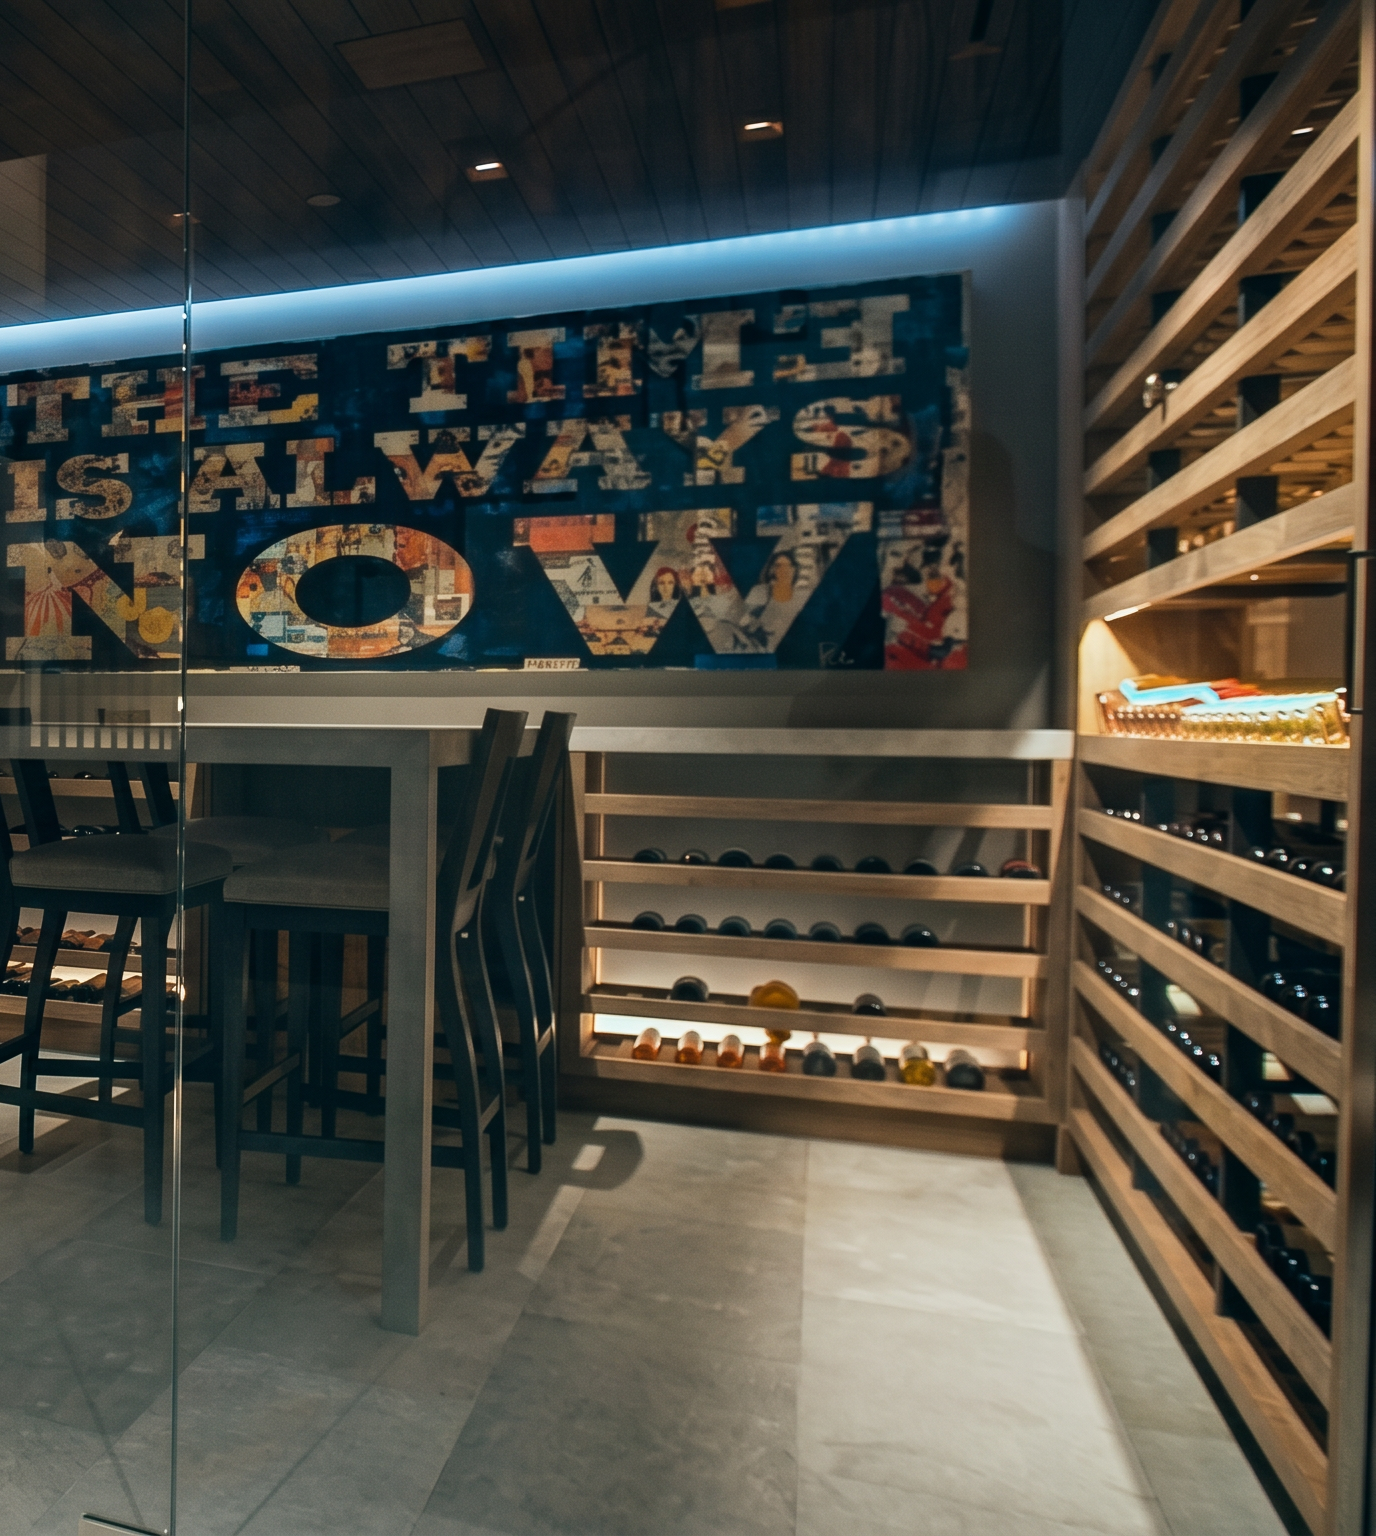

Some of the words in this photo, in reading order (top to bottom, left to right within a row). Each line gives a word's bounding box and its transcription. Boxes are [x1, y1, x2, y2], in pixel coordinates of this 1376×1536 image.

[5, 452, 133, 523] IS
[178, 395, 914, 513] ALWAYS
[6, 353, 319, 445] THE
[5, 502, 874, 661] NOW
